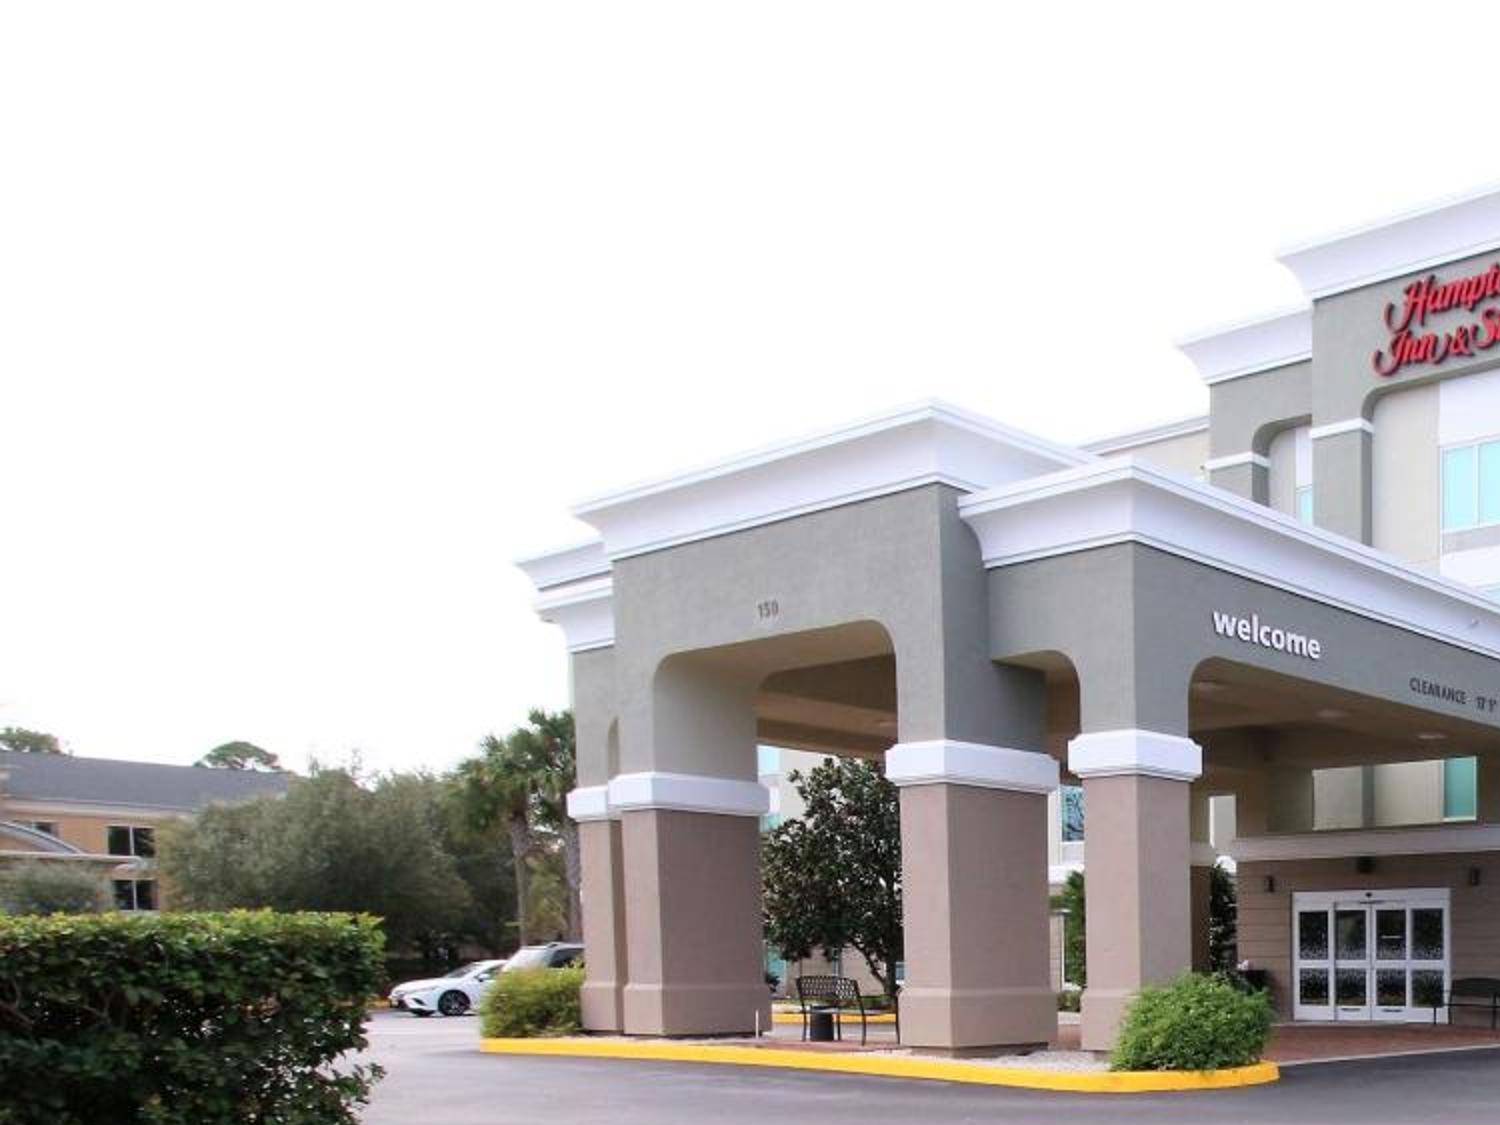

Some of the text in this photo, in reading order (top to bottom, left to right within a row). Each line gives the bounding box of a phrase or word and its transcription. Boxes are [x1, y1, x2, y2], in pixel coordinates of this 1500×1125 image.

[1372, 331, 1450, 376] Inn
[1452, 327, 1474, 356] &
[1212, 611, 1321, 659] welcome
[1409, 677, 1466, 705] CLEARANCE
